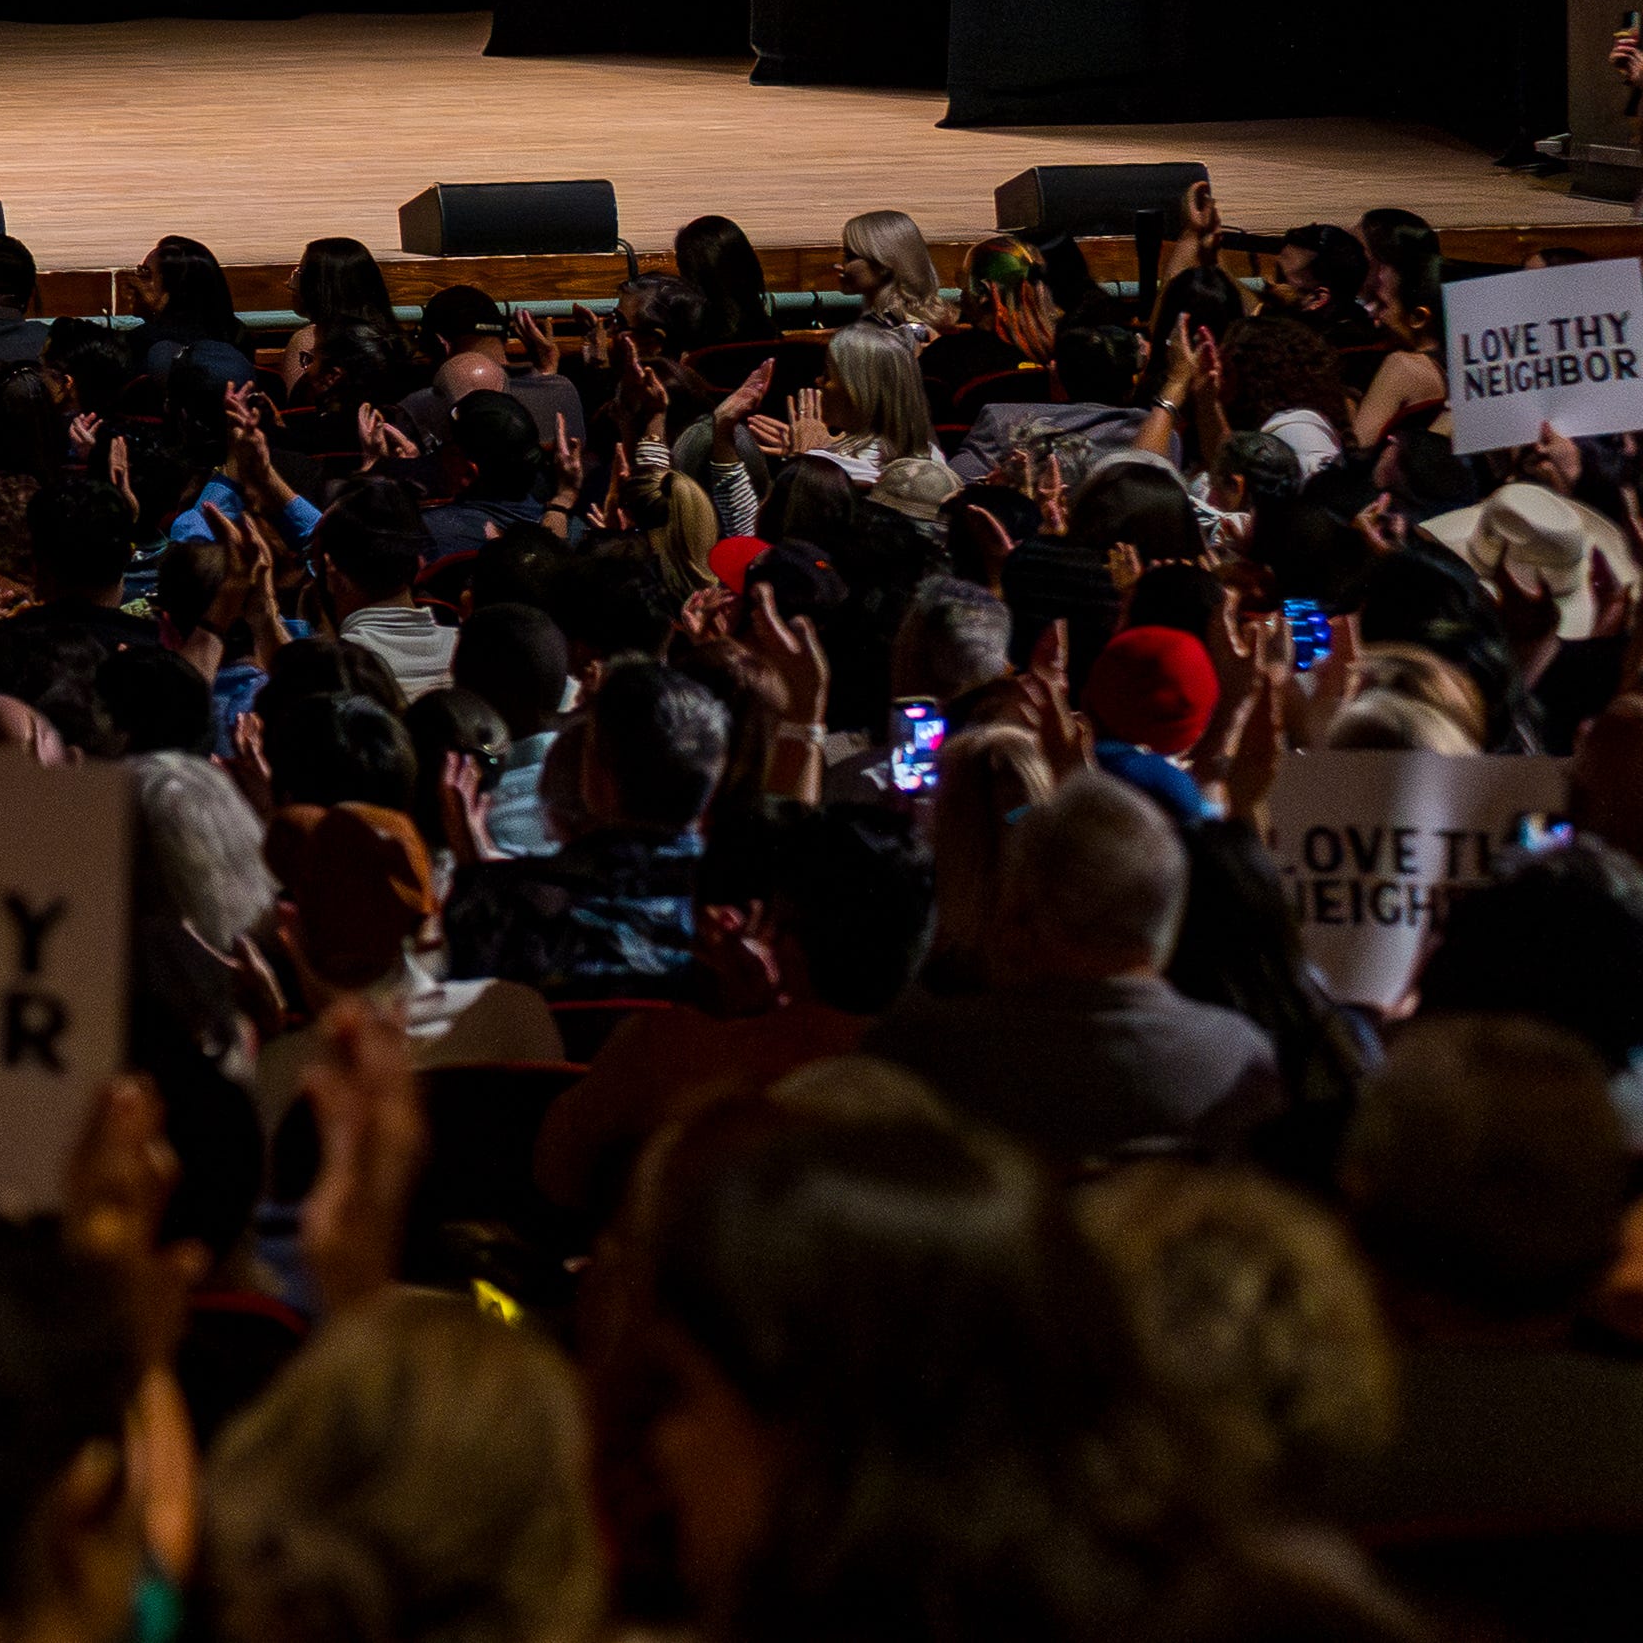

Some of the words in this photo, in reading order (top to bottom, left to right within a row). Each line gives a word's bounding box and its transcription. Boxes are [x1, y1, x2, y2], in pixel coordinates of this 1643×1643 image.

[1461, 321, 1540, 366] LOVE
[1549, 310, 1631, 352] THY
[1464, 349, 1639, 401] NEIGHBOR
[1297, 879, 1438, 933] EIGH
